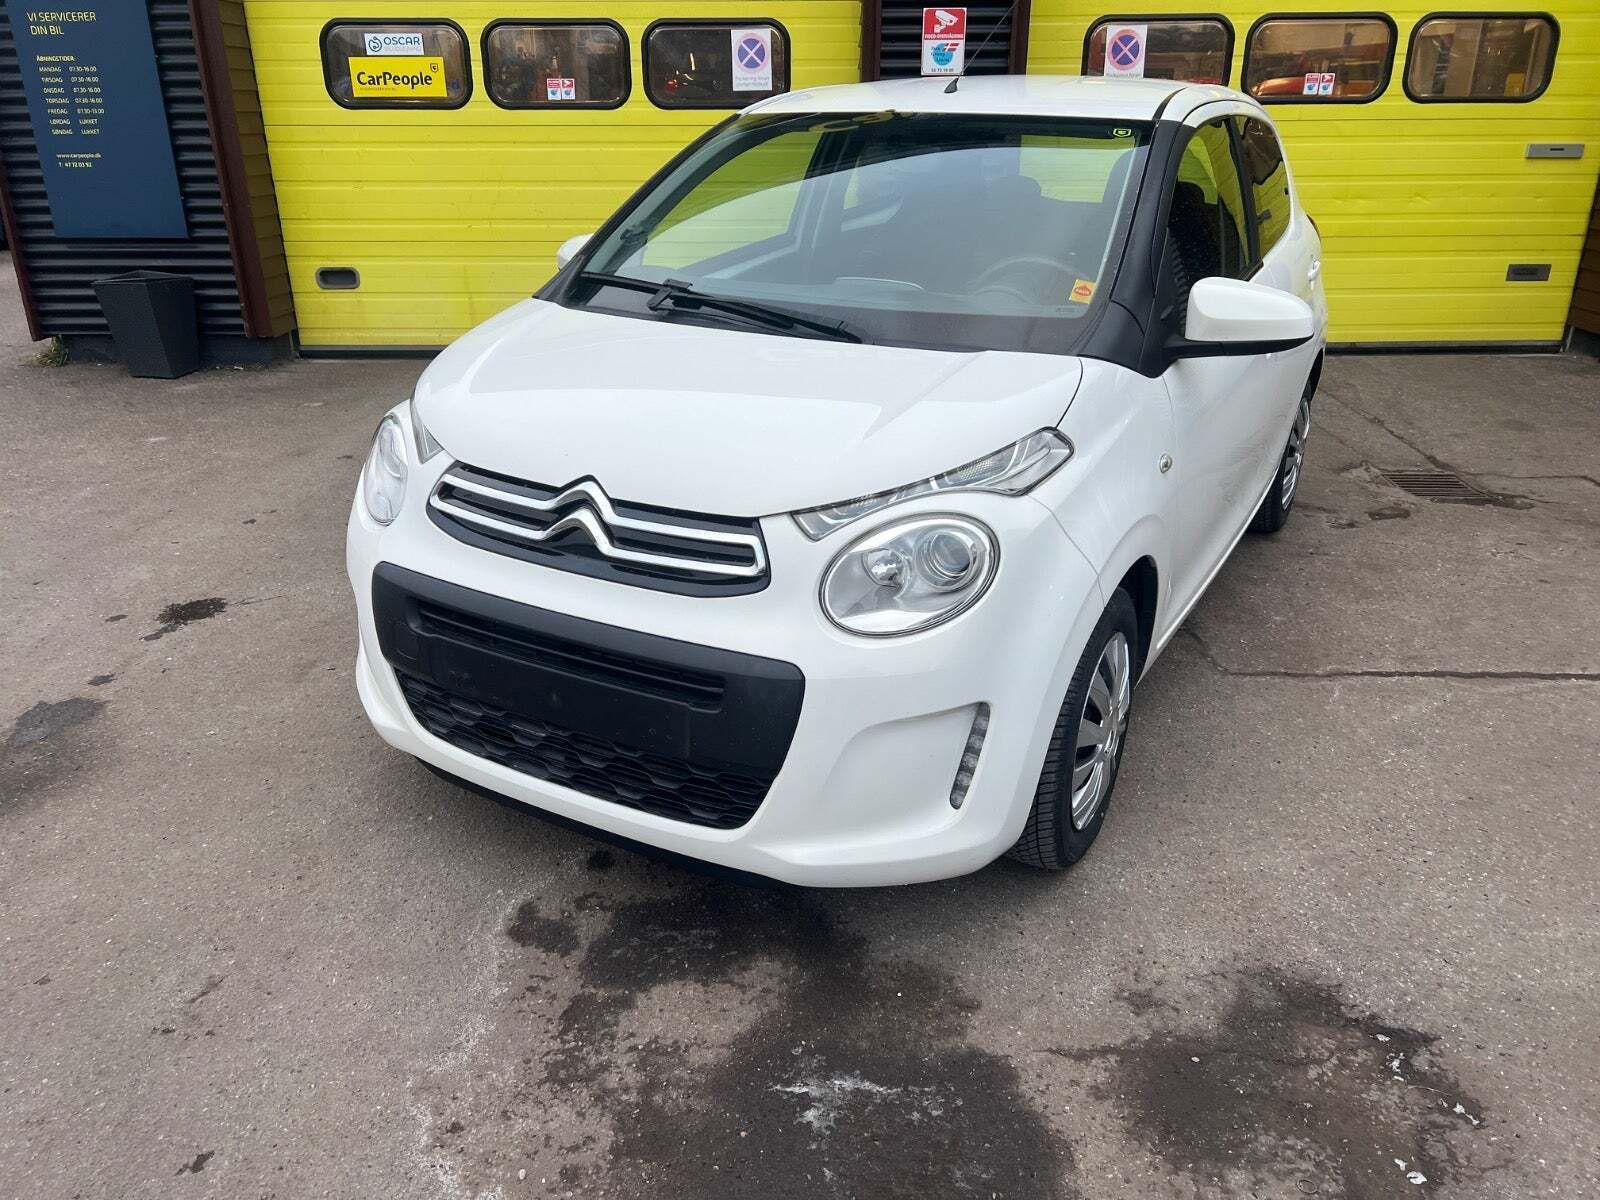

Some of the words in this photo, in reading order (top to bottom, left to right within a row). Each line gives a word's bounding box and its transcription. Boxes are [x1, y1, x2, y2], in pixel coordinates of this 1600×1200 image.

[27, 12, 38, 22] VI
[38, 11, 97, 22] SERVICERER
[30, 25, 48, 36] DIN
[49, 25, 65, 36] BIL
[383, 36, 421, 46] OSCAR
[356, 71, 433, 90] CarPeople
